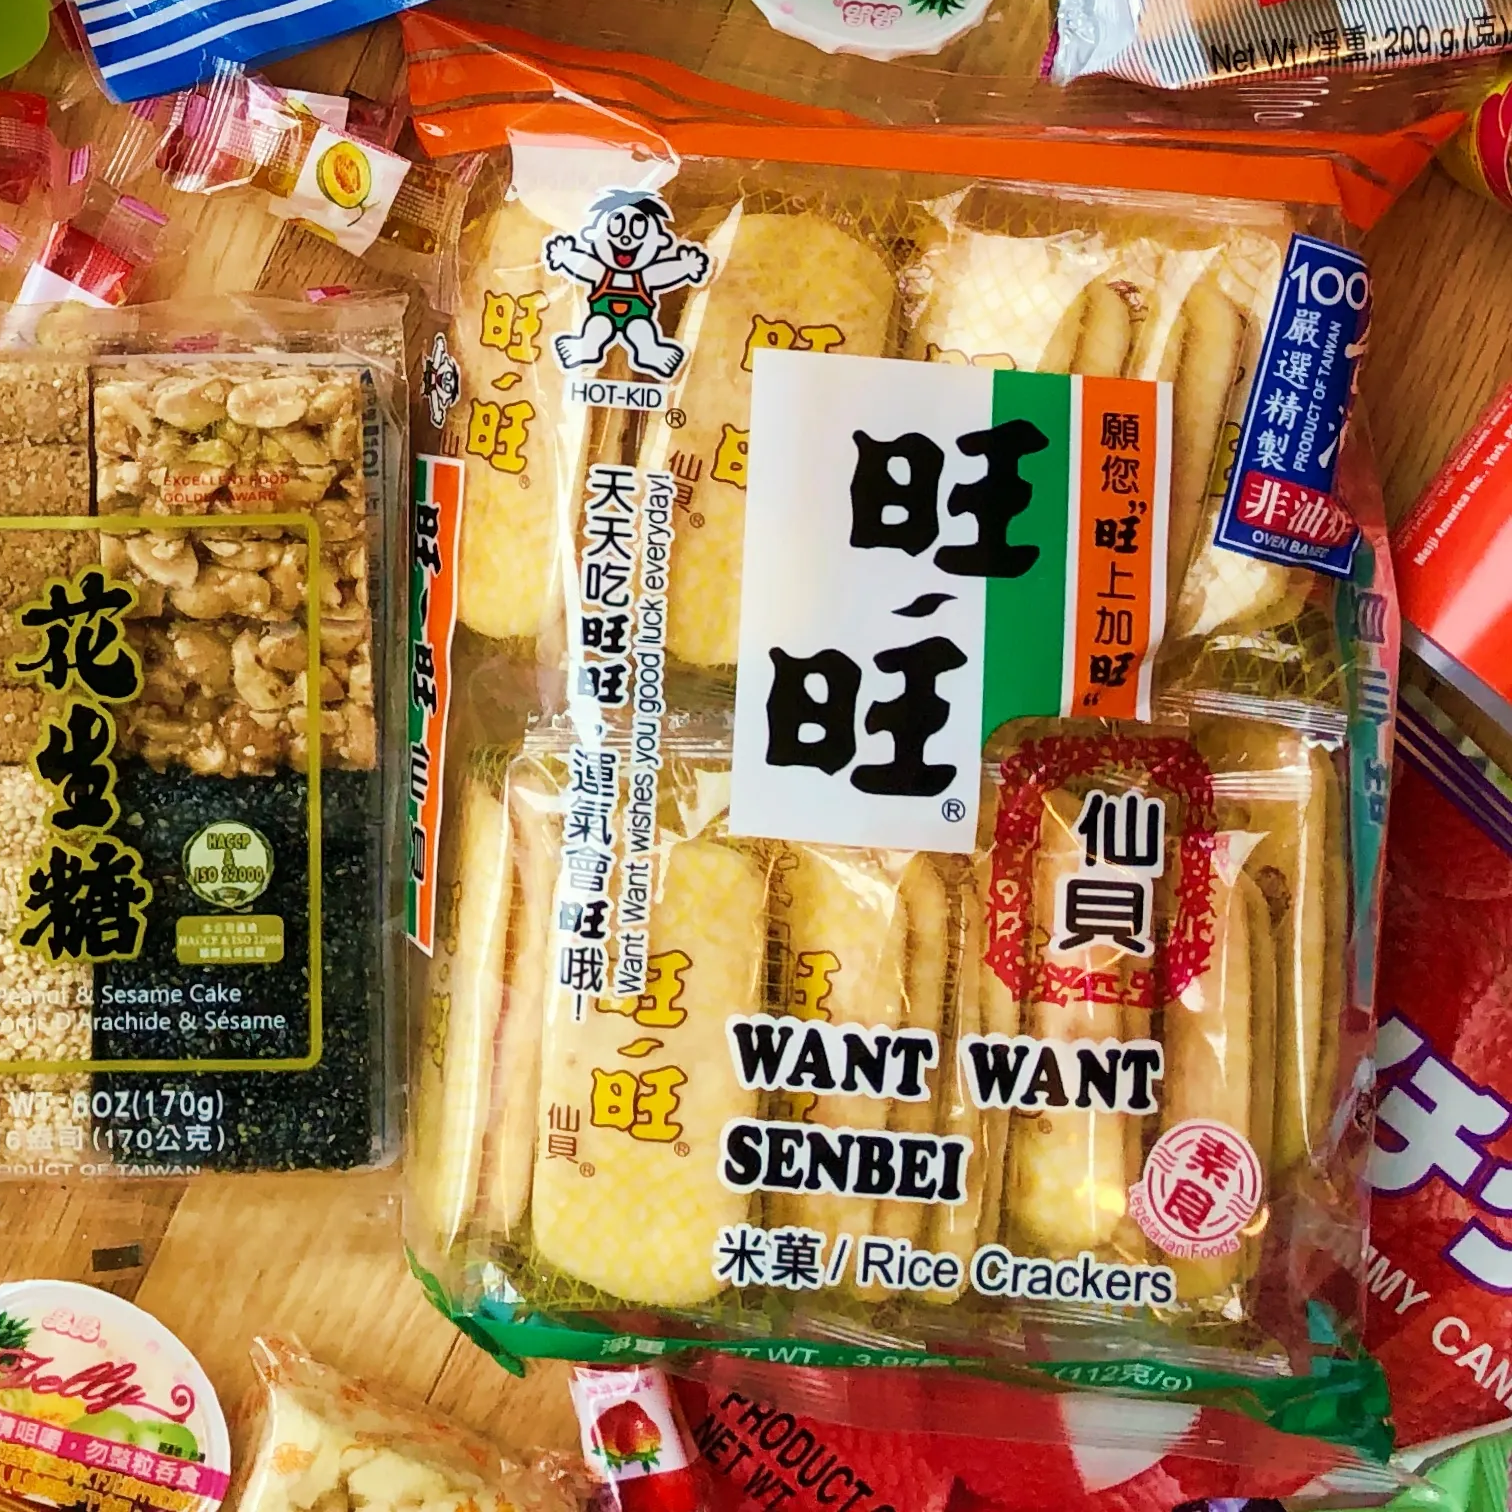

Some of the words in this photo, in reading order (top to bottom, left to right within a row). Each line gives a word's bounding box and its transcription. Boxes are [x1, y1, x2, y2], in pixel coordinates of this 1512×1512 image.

[1210, 43, 1257, 74] Net
[1384, 25, 1431, 58] 200
[1440, 28, 1454, 56] g
[1322, 322, 1343, 377] TAIWAN
[571, 382, 662, 410] HOT-KID
[1319, 380, 1329, 400] OF
[1293, 404, 1323, 473] PRODUCT
[163, 474, 244, 487] EXCELLENT
[643, 473, 674, 595] everyday!
[1252, 530, 1290, 553] OVEN
[1434, 493, 1470, 538] America
[642, 600, 665, 648] luck
[765, 418, 1050, 797] 旺旺
[636, 652, 664, 724] good
[17, 573, 149, 961] 花生糖
[631, 720, 659, 771] you
[207, 833, 251, 849] HACCP
[629, 773, 654, 850] wishes
[194, 866, 218, 883] ISO
[221, 865, 265, 884] 22000
[622, 859, 650, 925] Want
[1057, 791, 1163, 954] 仙貝
[76, 986, 94, 1005] &
[101, 985, 182, 1004] Sesame
[189, 983, 242, 1003] Cake
[615, 934, 644, 995] Want
[178, 1012, 197, 1030] &
[204, 1010, 286, 1030] Sésame
[733, 1022, 934, 1095] WANT
[968, 1042, 1162, 1110] WANT
[79, 1163, 108, 1176] OF
[117, 1163, 201, 1176] TAIWAN
[724, 1127, 966, 1202] SENBEI
[1163, 1131, 1242, 1234] 素食
[1131, 1182, 1185, 1257] Vegetarian
[1191, 1239, 1240, 1259] Foods
[717, 1232, 818, 1285] 米菓
[862, 1242, 959, 1287] Rice
[974, 1252, 1174, 1303] Crackers
[691, 1414, 751, 1476] NET
[722, 1392, 876, 1509] PRODUCT
